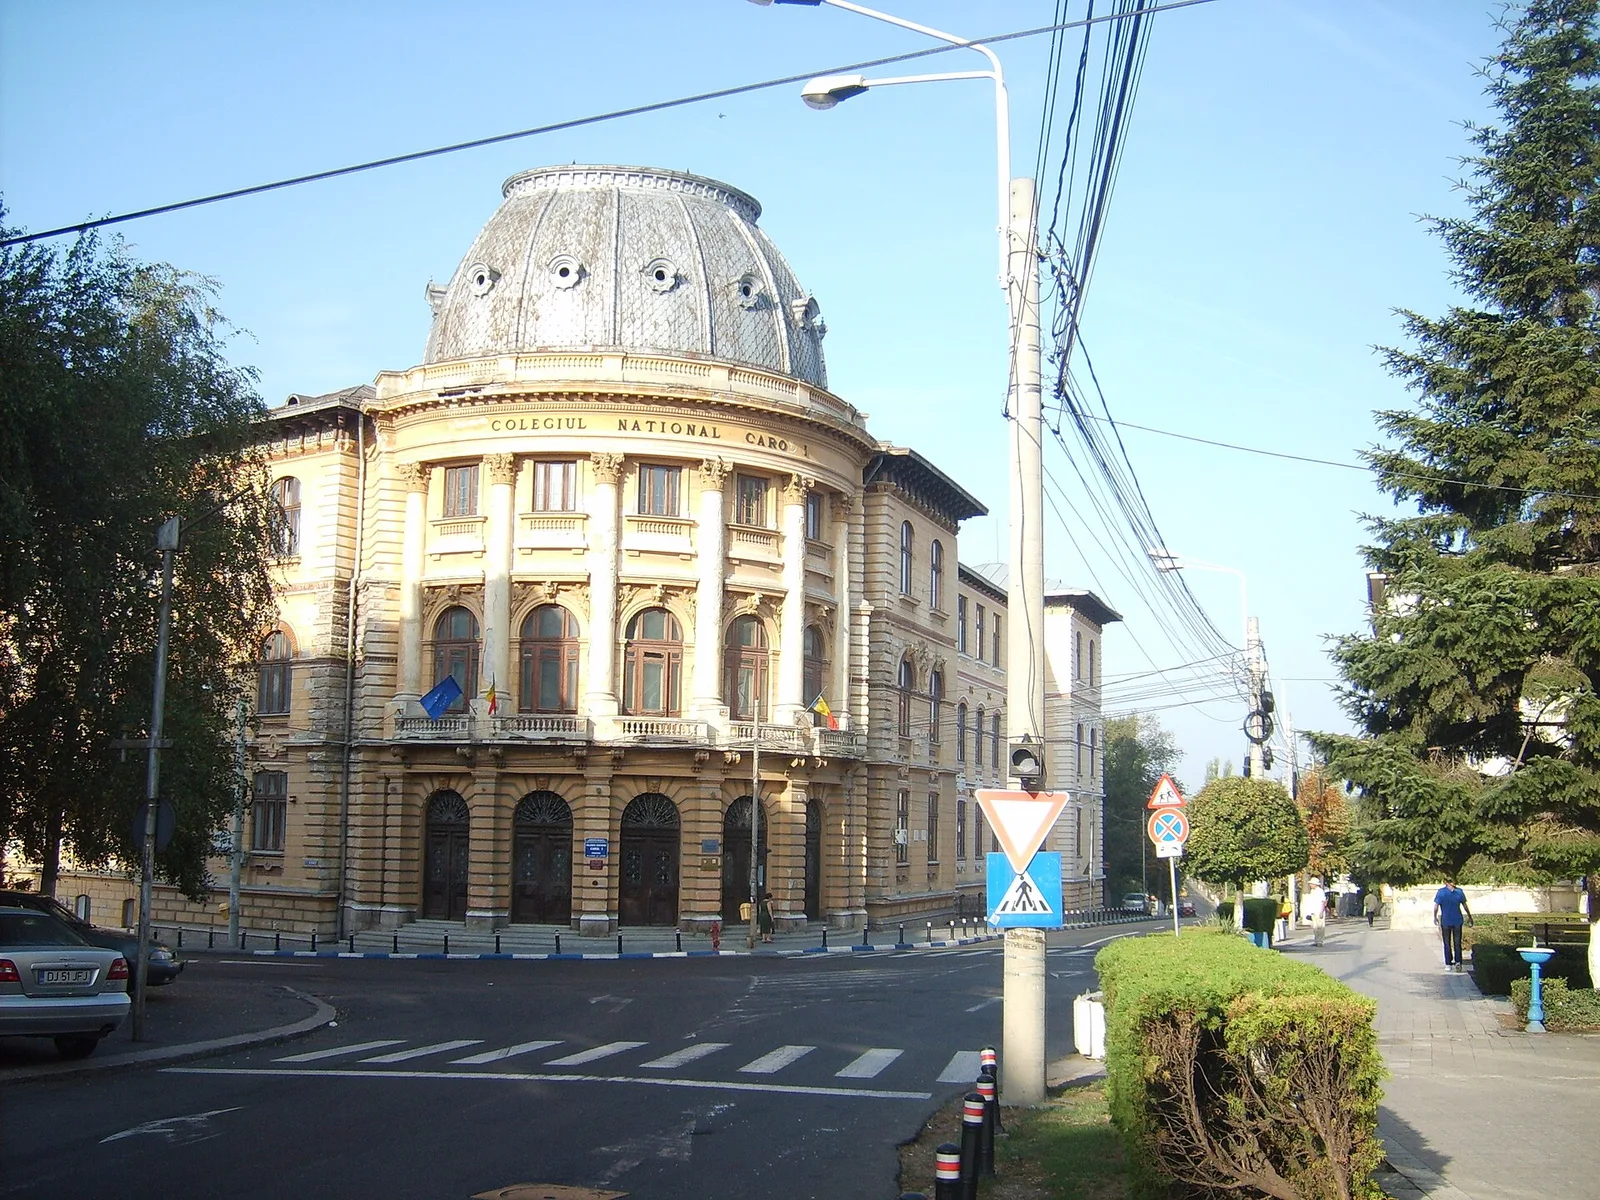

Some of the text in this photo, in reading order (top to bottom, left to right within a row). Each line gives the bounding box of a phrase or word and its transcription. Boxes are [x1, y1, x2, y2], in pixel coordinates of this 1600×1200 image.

[491, 417, 587, 432] COLEGIUL
[617, 419, 721, 439] NATIONAL
[47, 971, 59, 981] DJ
[61, 971, 70, 981] 51
